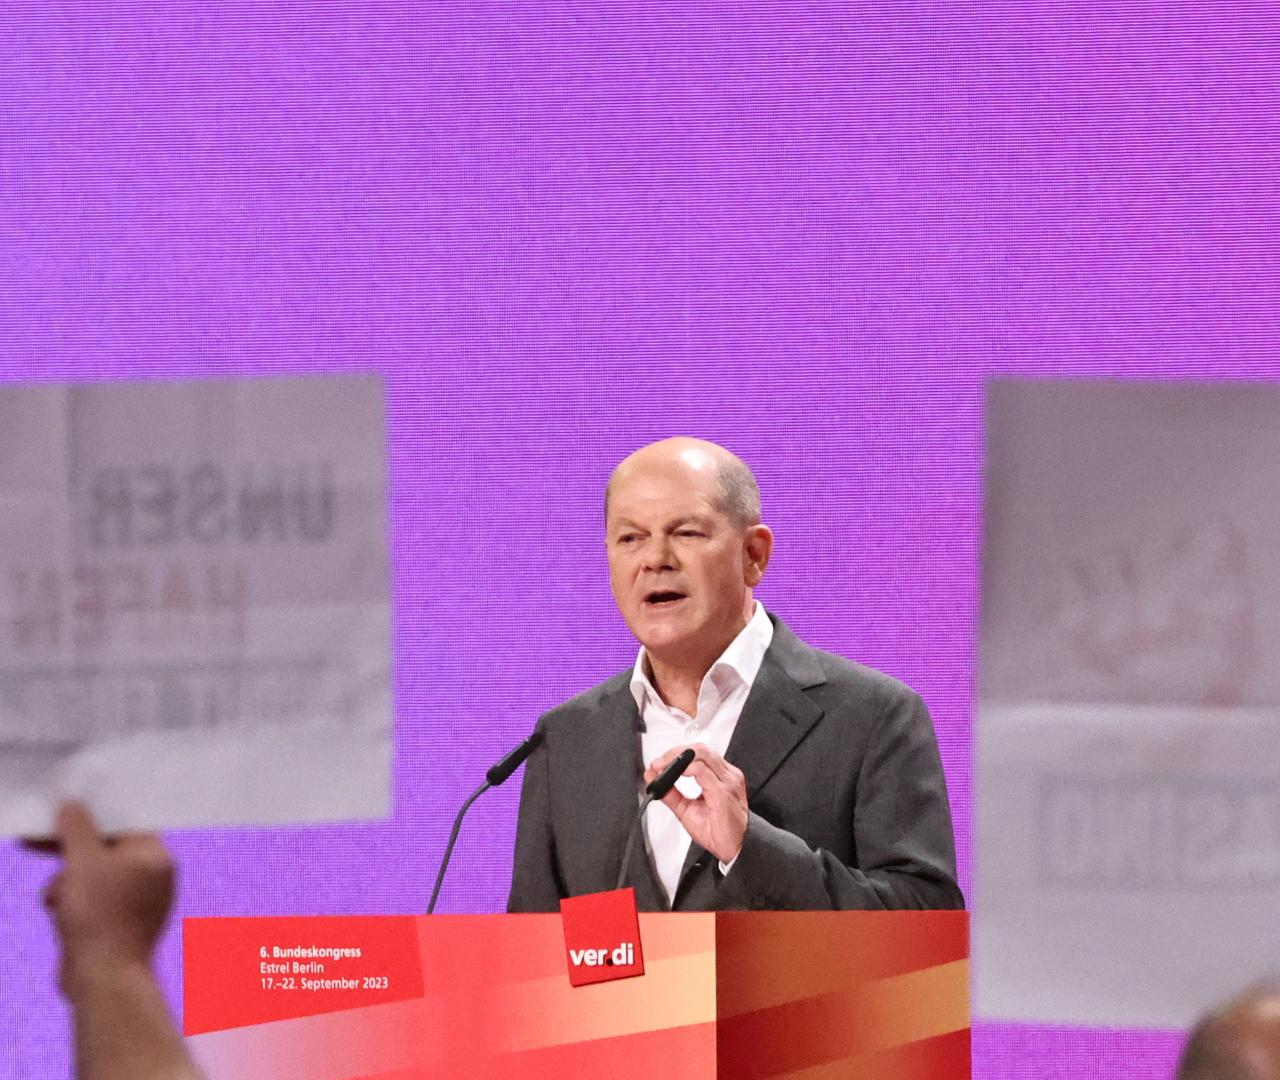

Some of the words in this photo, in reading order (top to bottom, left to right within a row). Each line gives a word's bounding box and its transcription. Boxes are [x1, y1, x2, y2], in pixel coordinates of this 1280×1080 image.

[260, 946, 270, 958] 6.
[272, 945, 362, 960] Bundeskongress
[569, 942, 634, 966] ver.di
[260, 961, 290, 973] Estrel
[292, 961, 324, 973] Berlin
[301, 977, 360, 992] September
[363, 976, 388, 989] 2023
